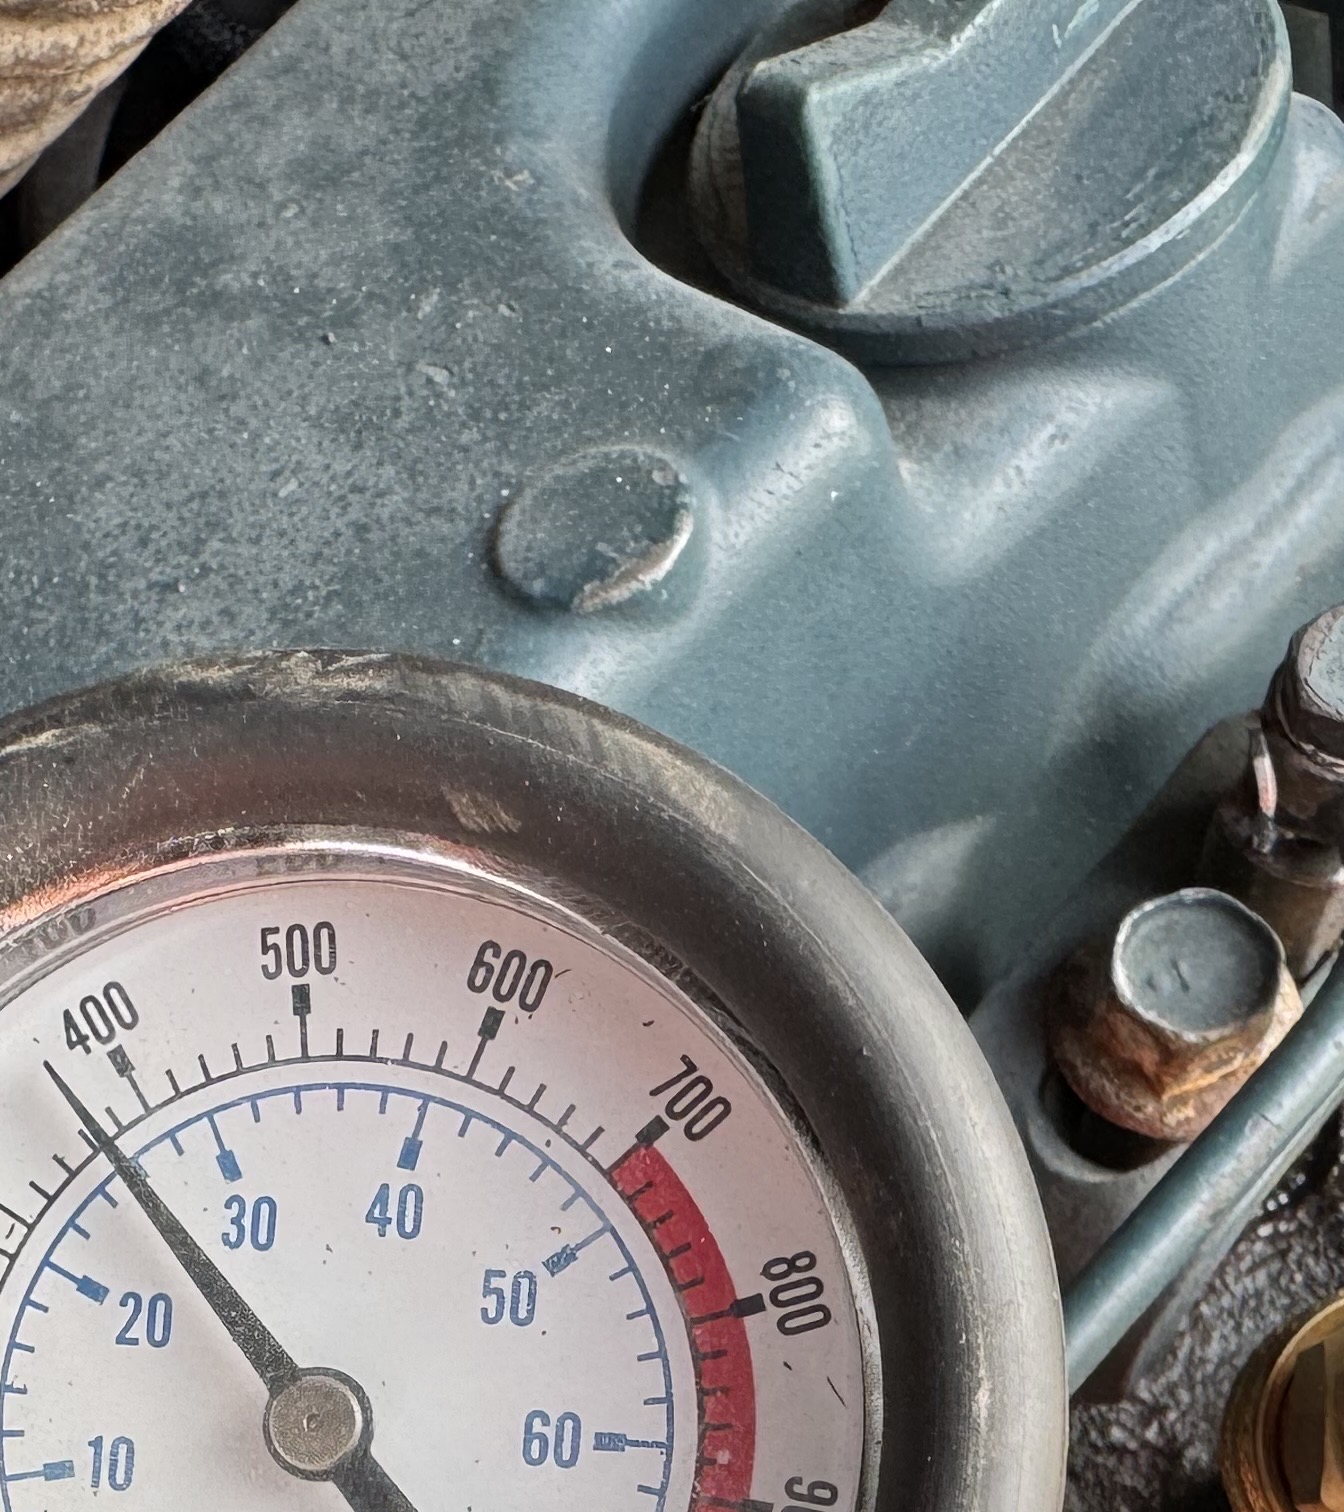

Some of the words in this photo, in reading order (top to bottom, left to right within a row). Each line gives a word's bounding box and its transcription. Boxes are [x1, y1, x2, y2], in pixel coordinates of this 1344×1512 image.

[260, 921, 337, 981] 500
[466, 939, 555, 1014] 600
[63, 980, 140, 1056] 400
[649, 1053, 733, 1142] 700
[220, 1195, 278, 1252] 30
[364, 1183, 425, 1241] 40
[115, 1292, 173, 1349] 20
[479, 1268, 539, 1327] 50
[760, 1250, 832, 1337] 800
[87, 1435, 136, 1492] 10
[522, 1409, 582, 1469] 60
